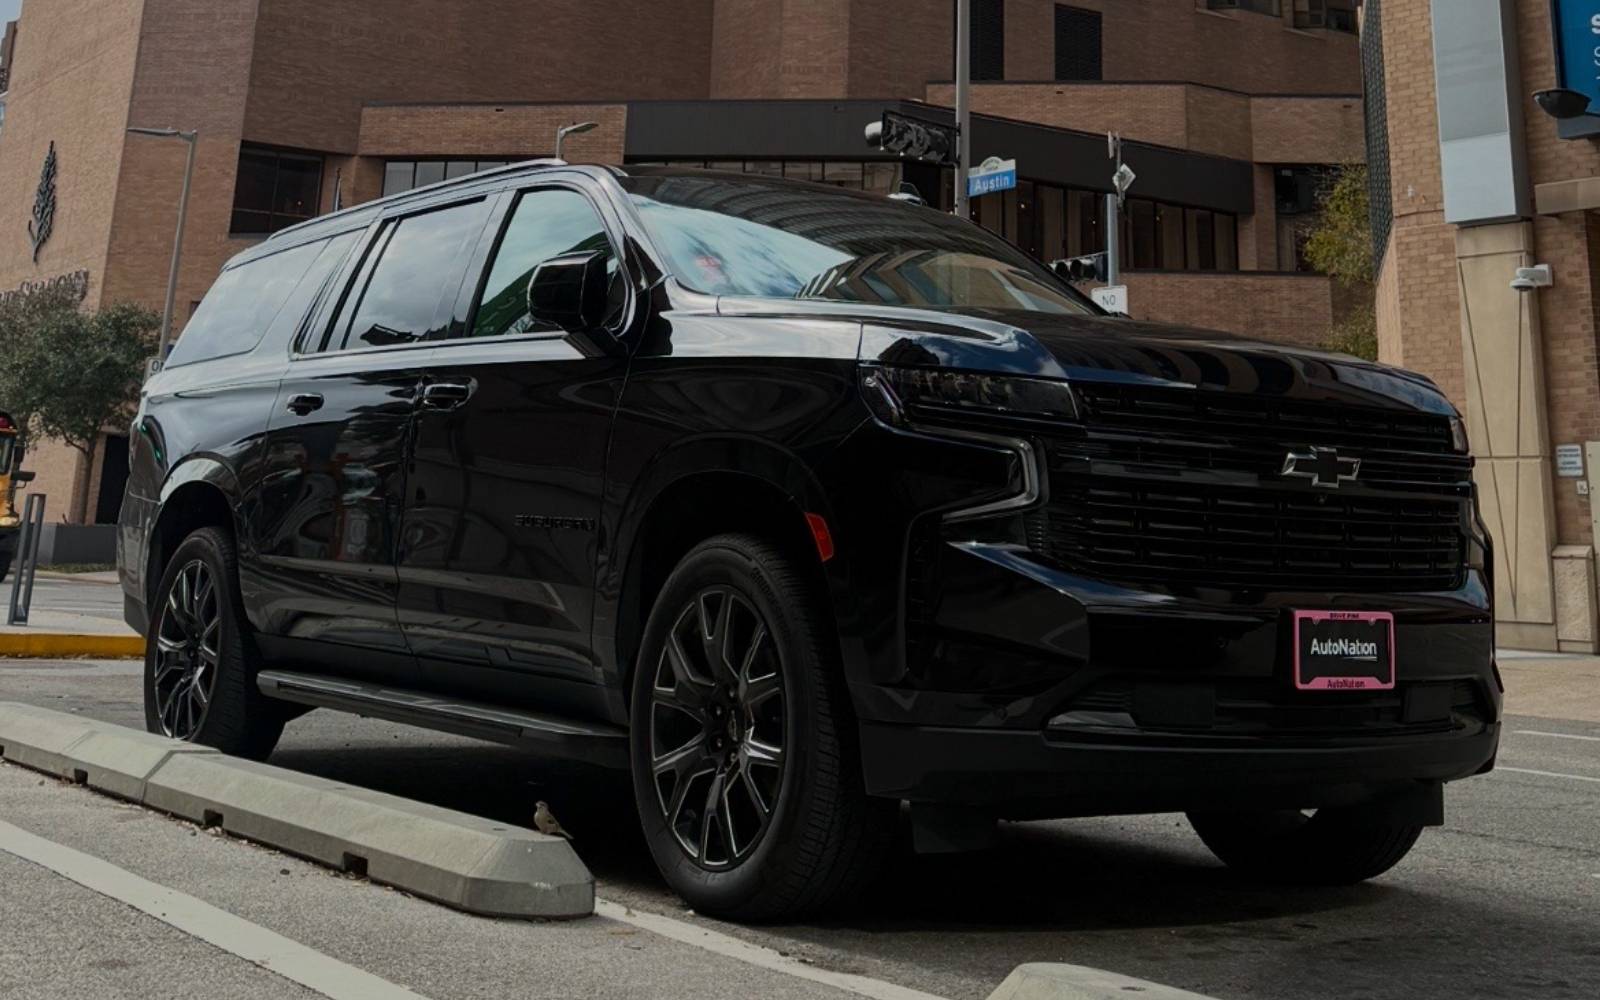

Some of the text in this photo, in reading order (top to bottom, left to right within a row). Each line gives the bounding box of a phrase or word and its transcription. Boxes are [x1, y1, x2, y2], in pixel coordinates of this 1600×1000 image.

[975, 174, 1009, 191] Austin
[1102, 295, 1116, 306] NO
[1310, 638, 1377, 656] AutoNation
[1327, 680, 1365, 688] AutoNation
